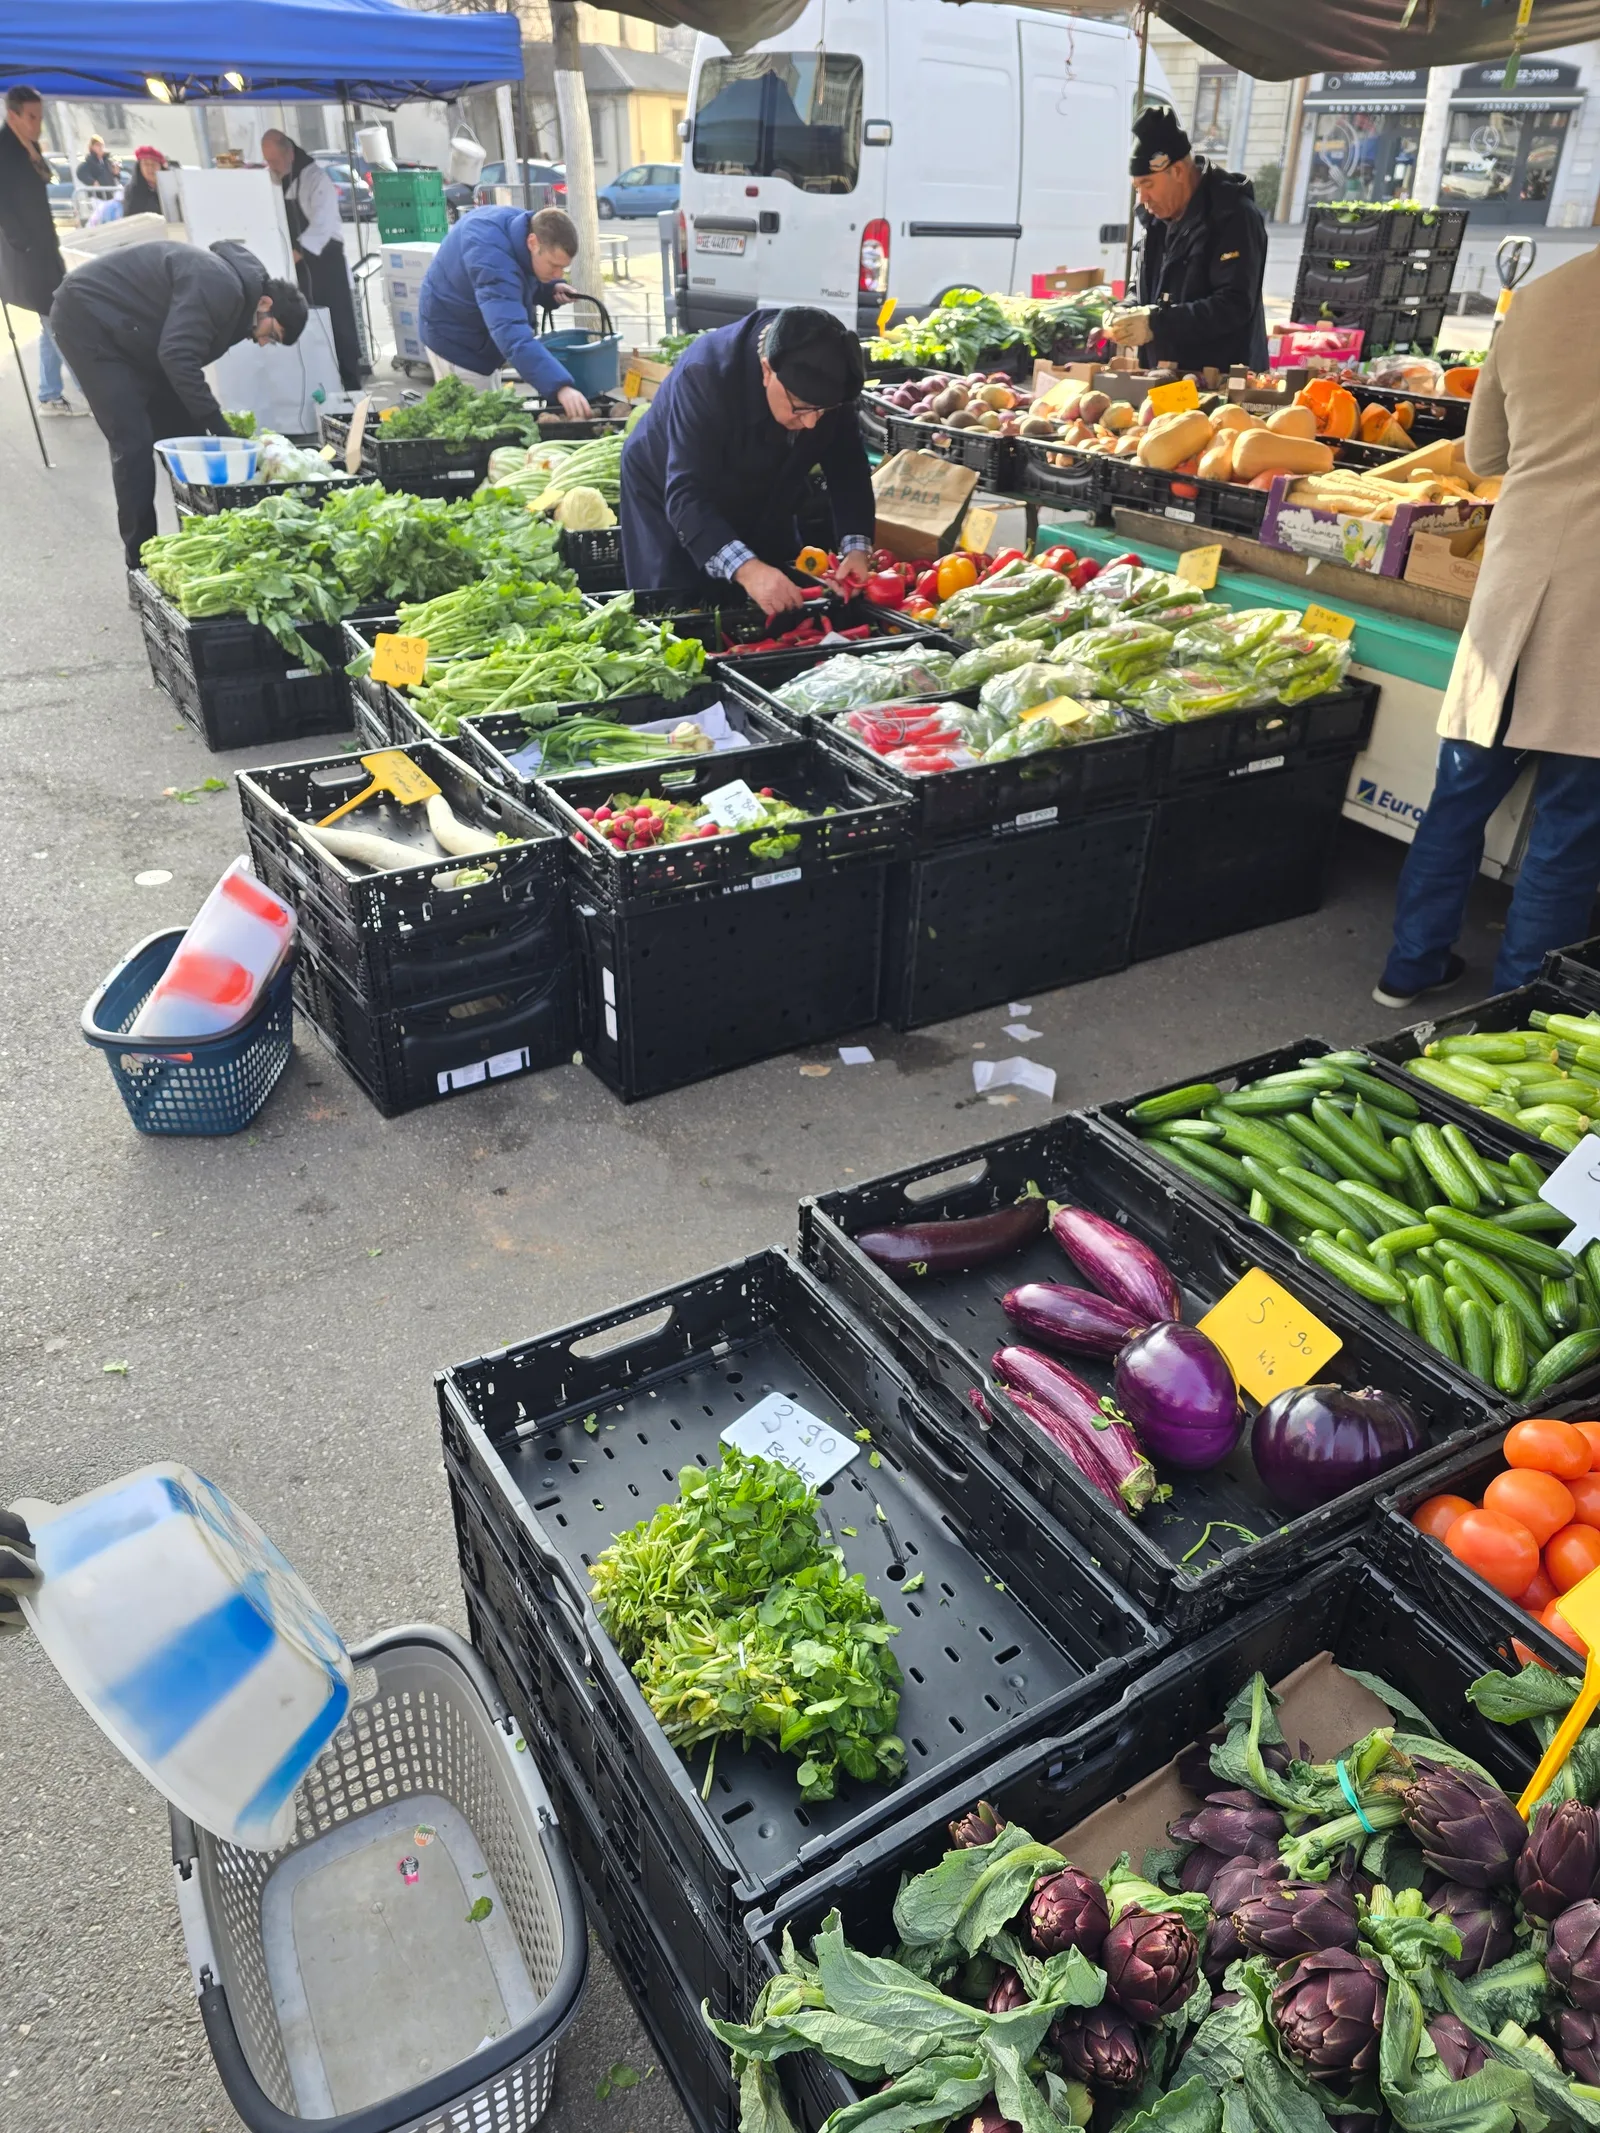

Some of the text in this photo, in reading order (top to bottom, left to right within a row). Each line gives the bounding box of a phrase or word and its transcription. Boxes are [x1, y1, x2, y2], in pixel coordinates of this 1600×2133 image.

[901, 485, 940, 505] PALA
[1377, 789, 1424, 822] Euro
[763, 1441, 816, 1483] Botte
